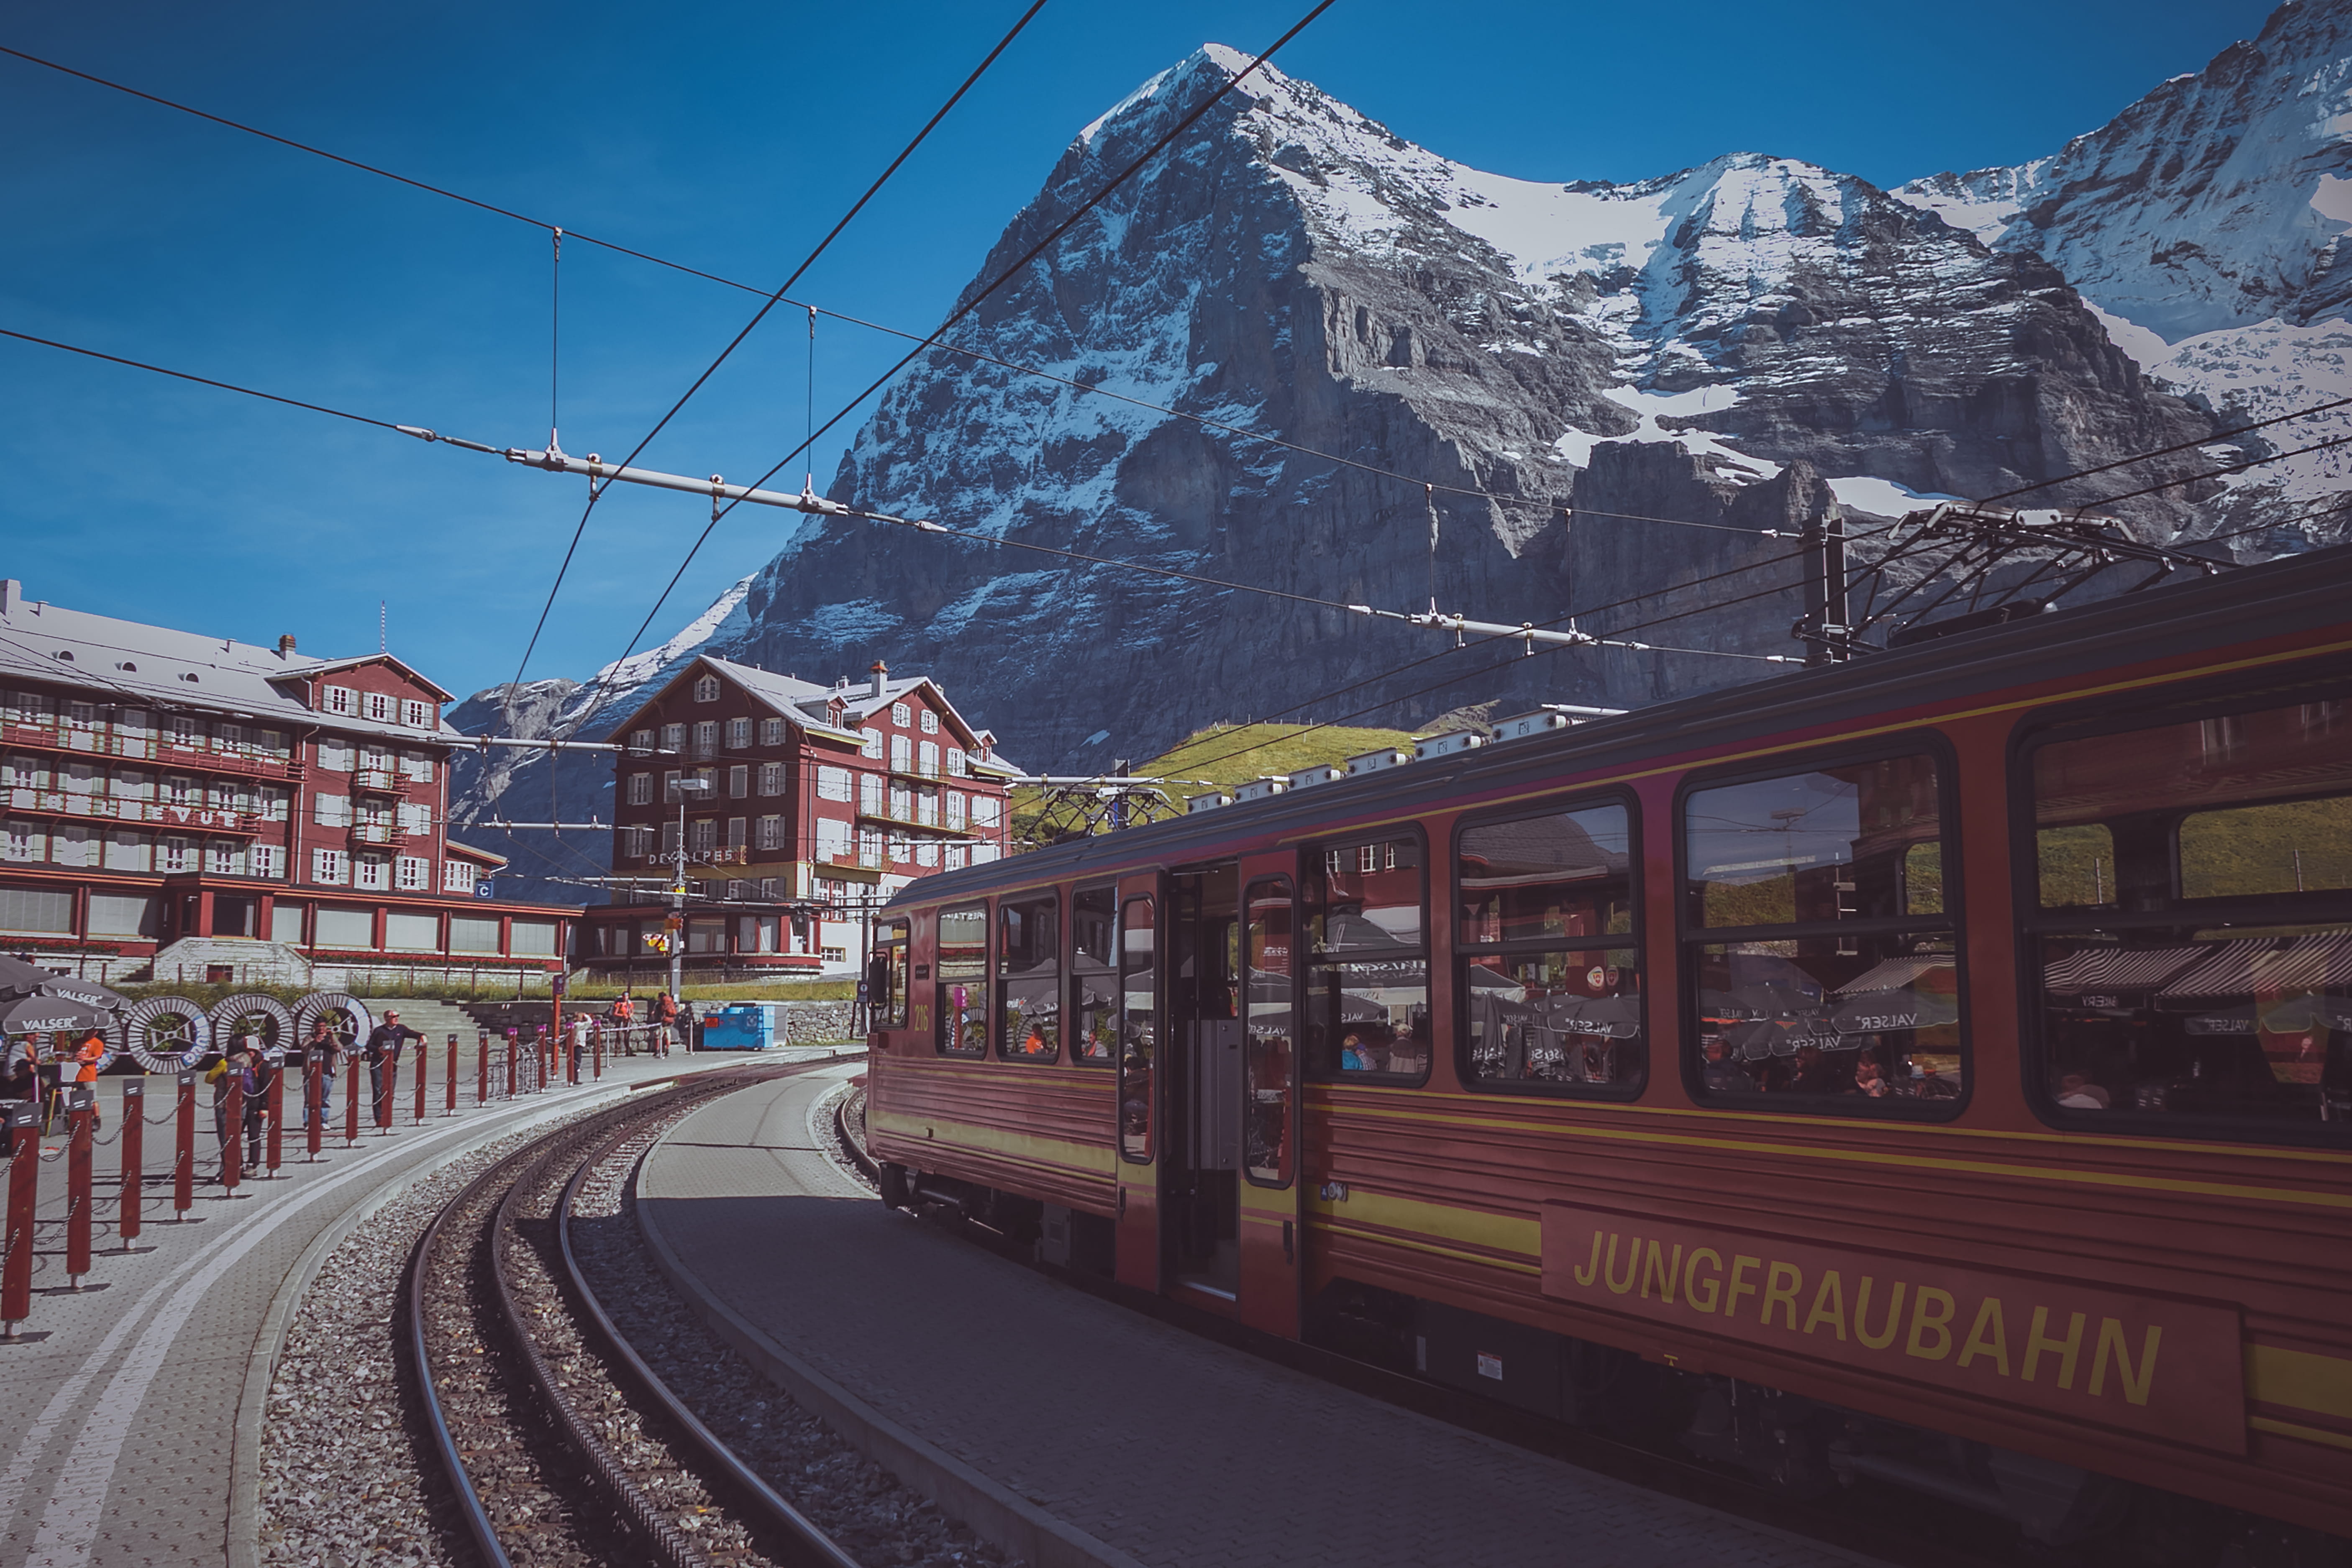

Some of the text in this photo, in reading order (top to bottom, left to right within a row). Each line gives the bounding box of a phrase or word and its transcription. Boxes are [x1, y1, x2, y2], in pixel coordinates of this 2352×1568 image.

[46, 795, 235, 828] BLEVUE
[480, 886, 489, 896] C
[57, 989, 99, 1006] VALSER
[22, 1018, 74, 1030] VALSER
[915, 1004, 928, 1031] 216
[1573, 1230, 2162, 1406] JUNGFRAUBAHN
